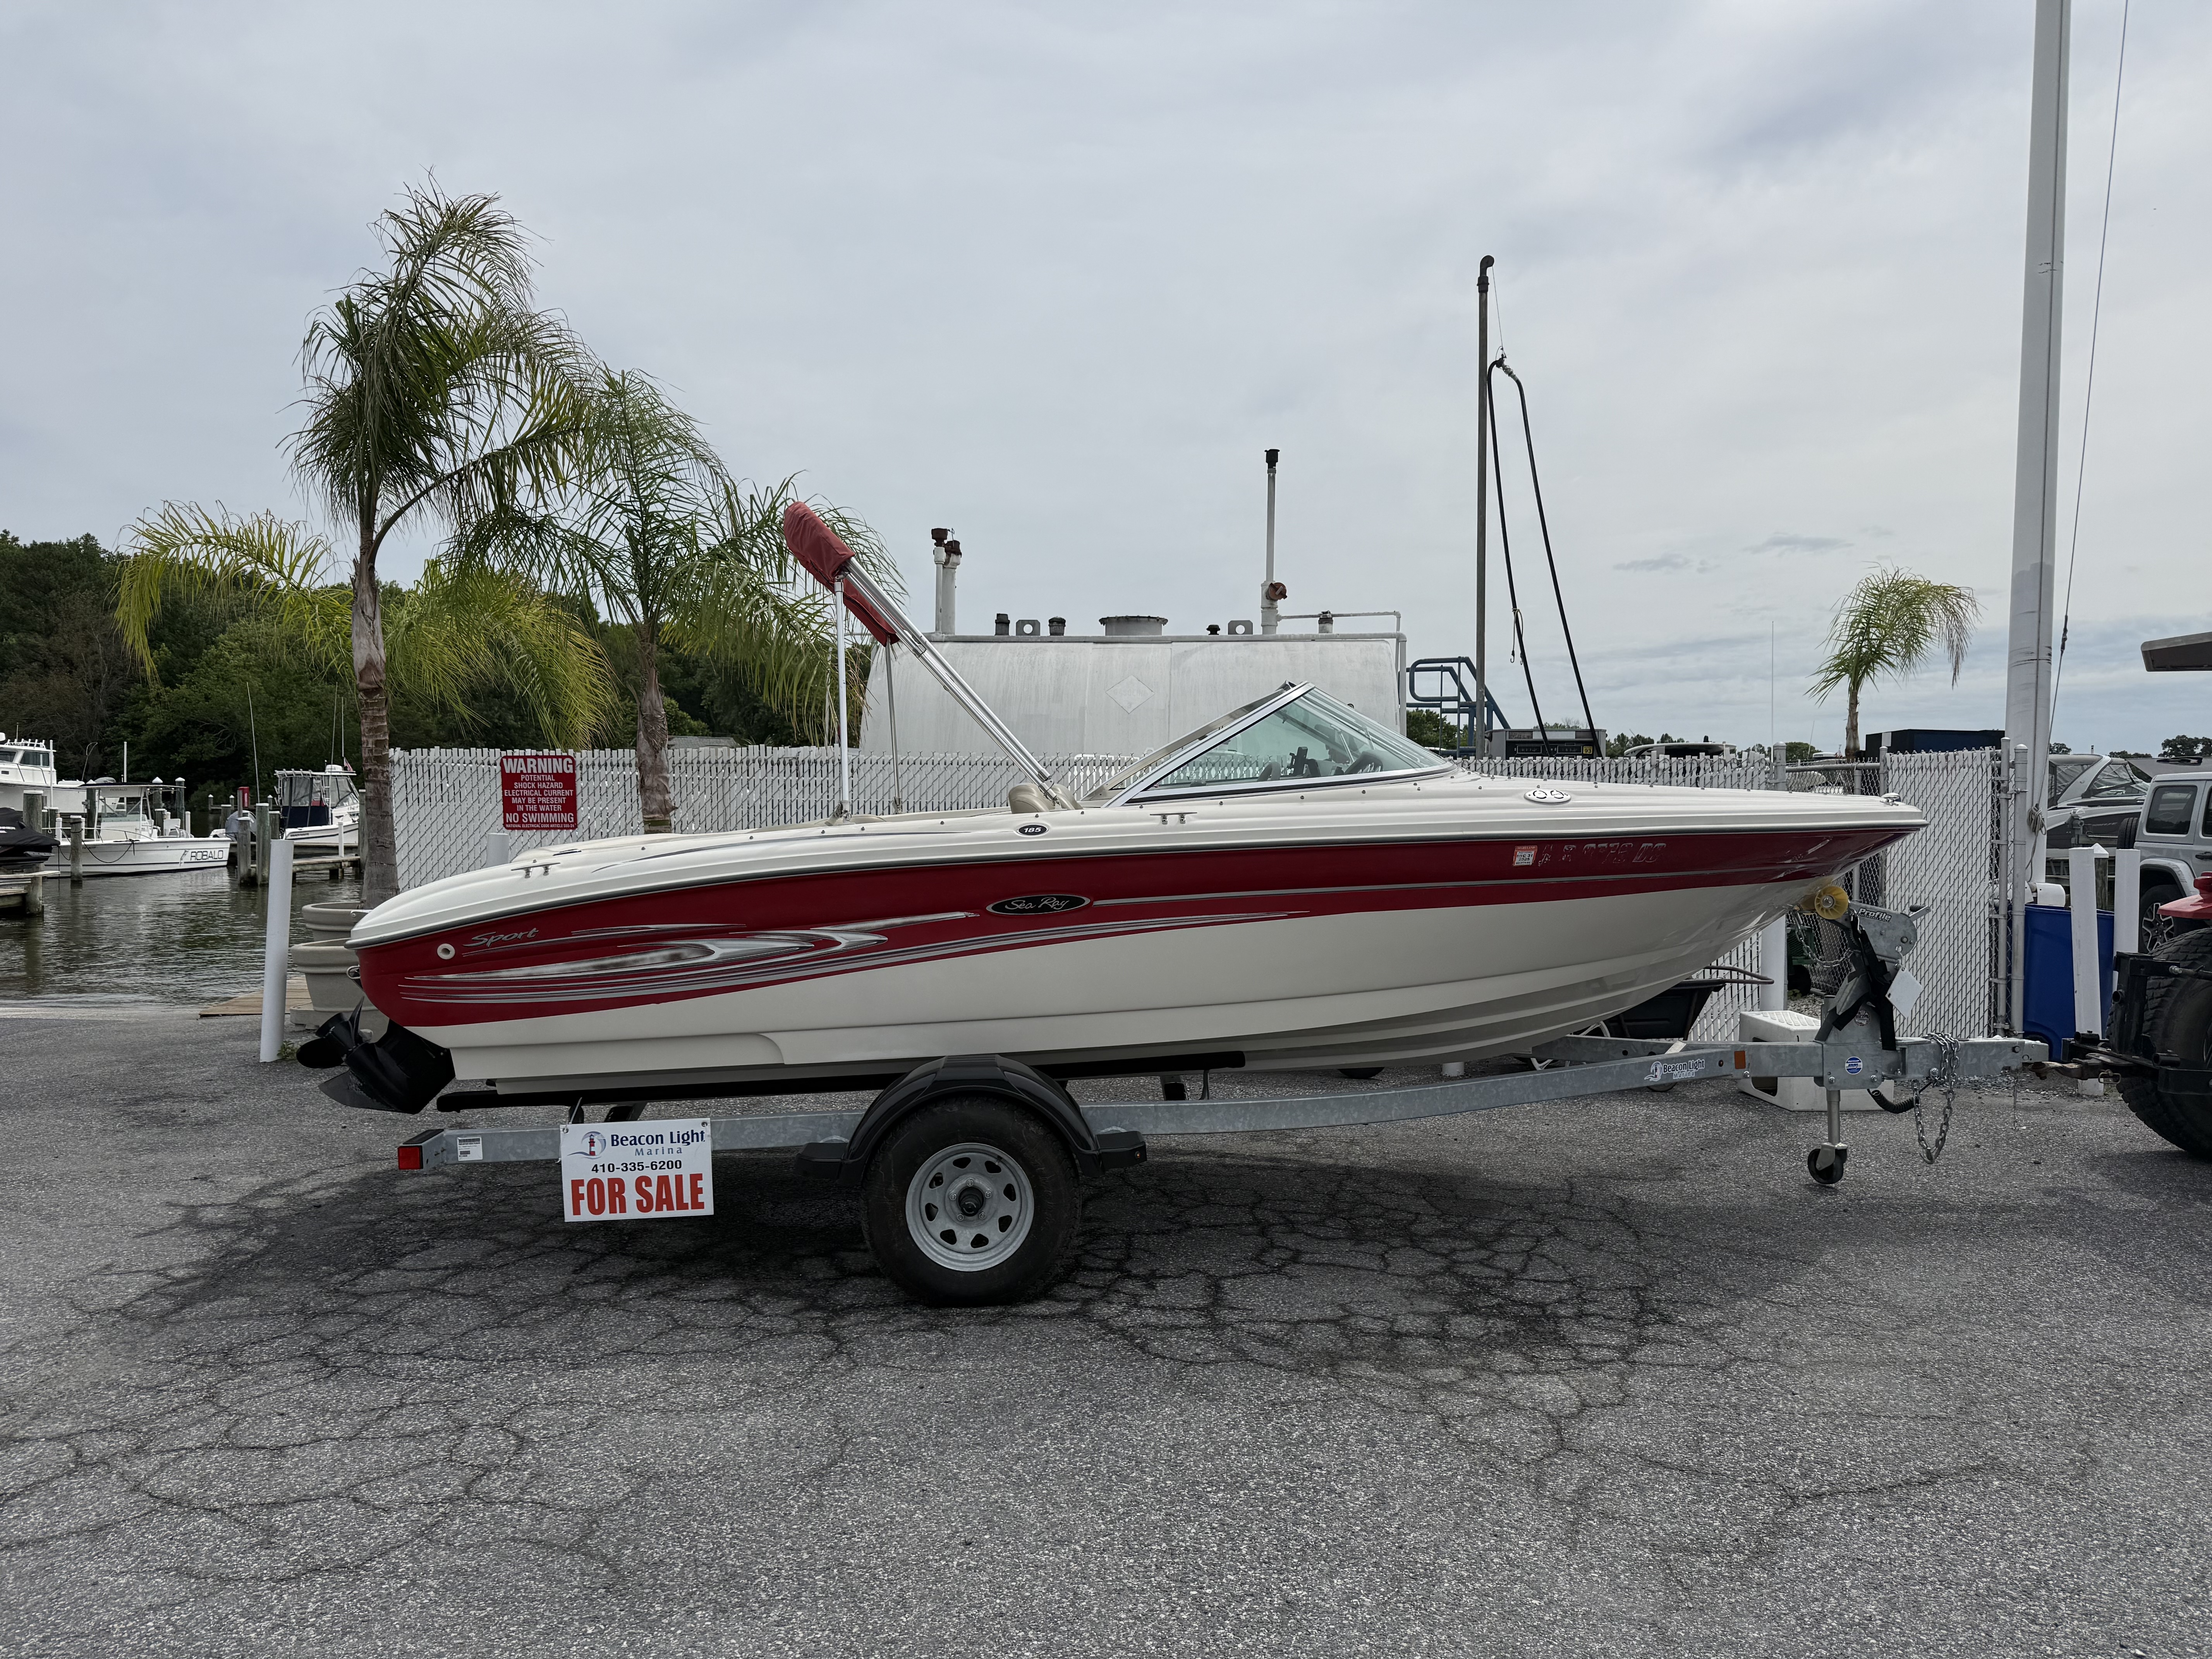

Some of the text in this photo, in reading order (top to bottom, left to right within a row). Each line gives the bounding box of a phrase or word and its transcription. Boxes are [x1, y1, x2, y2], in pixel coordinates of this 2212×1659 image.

[503, 758, 574, 773] WARNING
[506, 813, 574, 823] NO SWIMMING
[190, 850, 223, 860] ROBALO
[1005, 897, 1070, 910] Sea Ray
[1858, 908, 1891, 920] Profile
[462, 927, 539, 947] Sport
[1663, 1060, 1704, 1073] Beacon Light
[611, 1129, 705, 1147] Beacon Light
[635, 1147, 682, 1156] Marina
[591, 1160, 682, 1173] 410-335-6200
[571, 1173, 705, 1216] FOR SALE
